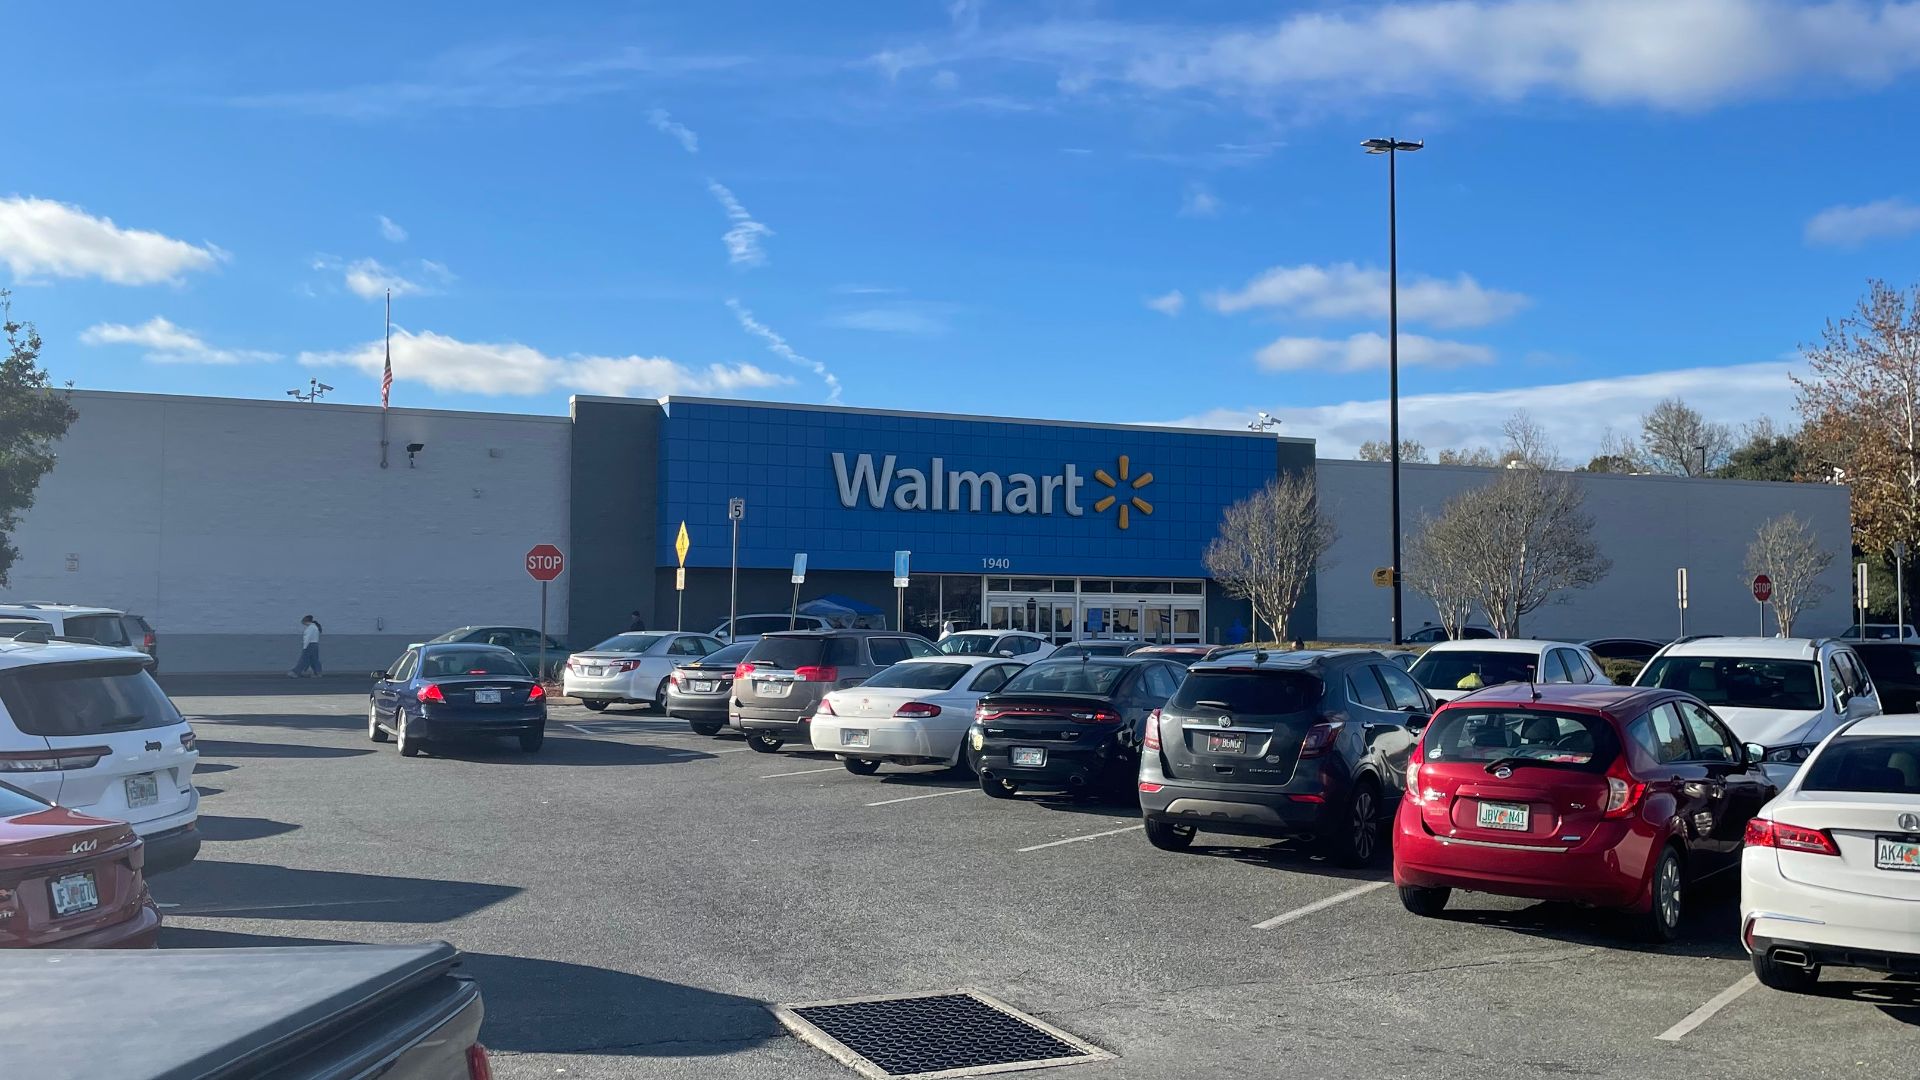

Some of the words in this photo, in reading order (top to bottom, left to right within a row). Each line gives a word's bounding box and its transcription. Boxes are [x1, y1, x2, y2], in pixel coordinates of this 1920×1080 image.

[832, 452, 1084, 516] Walmart
[735, 505, 741, 517] 5
[528, 555, 562, 570] STOP
[982, 558, 1010, 569] 1940
[1755, 582, 1771, 593] STOP
[72, 839, 97, 854] KIA
[1880, 845, 1904, 861] AK4
